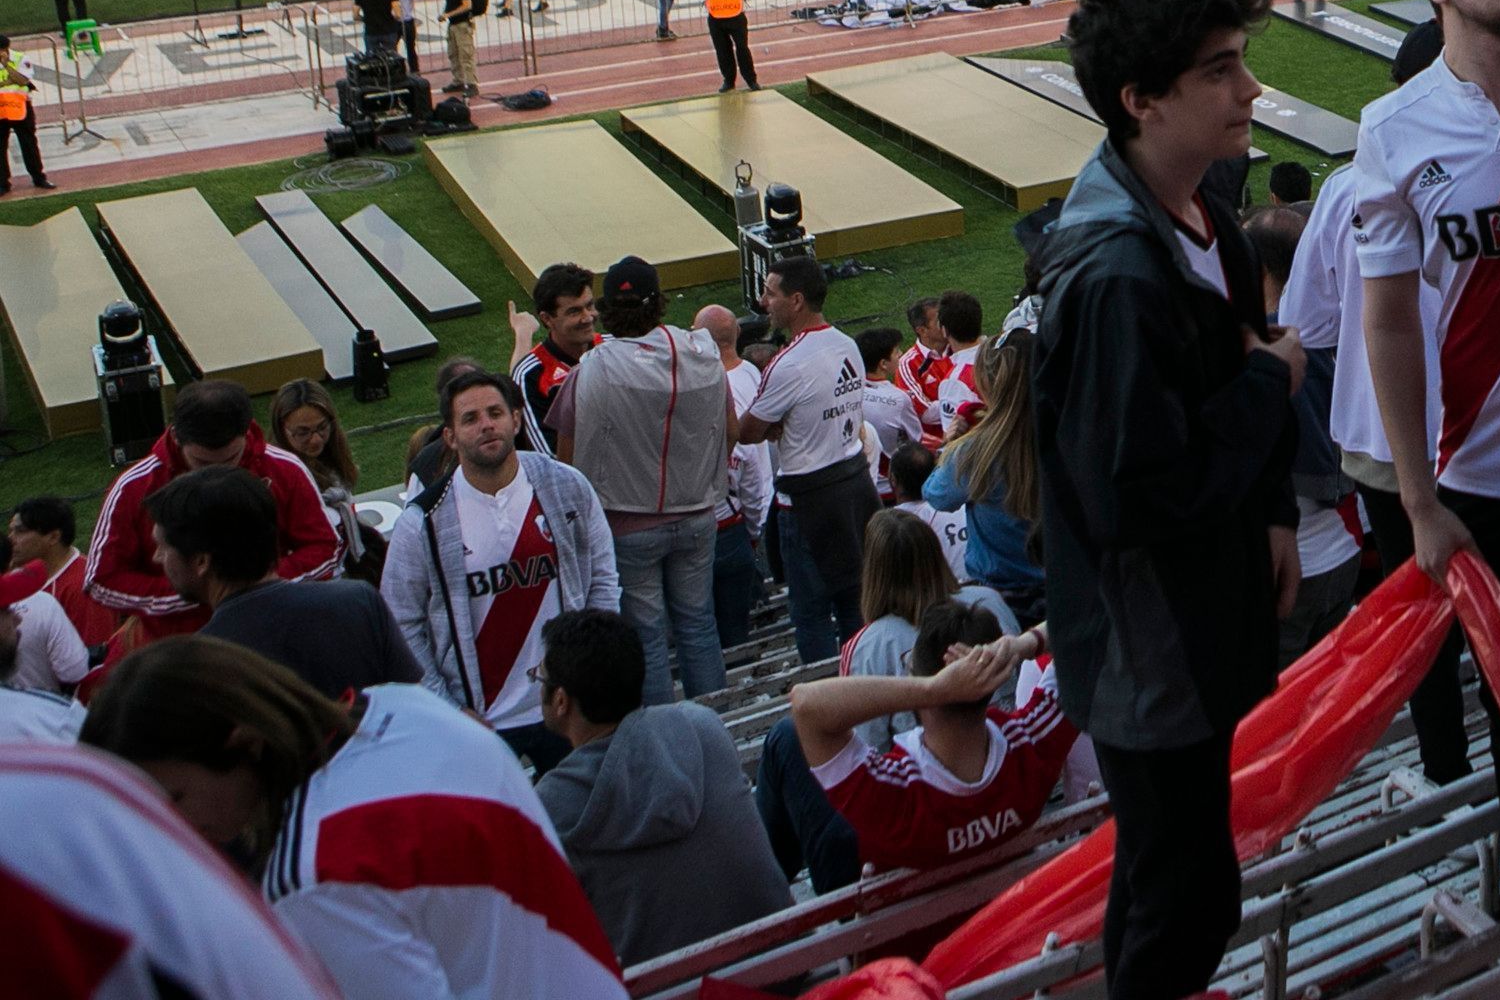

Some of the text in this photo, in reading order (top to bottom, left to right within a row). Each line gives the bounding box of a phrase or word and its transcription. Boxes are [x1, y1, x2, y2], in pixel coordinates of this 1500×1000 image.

[1418, 169, 1453, 188] adidas
[833, 379, 862, 397] adidas
[822, 403, 847, 421] BBVA
[465, 552, 559, 599] BBVA
[946, 807, 1024, 855] BBVA
